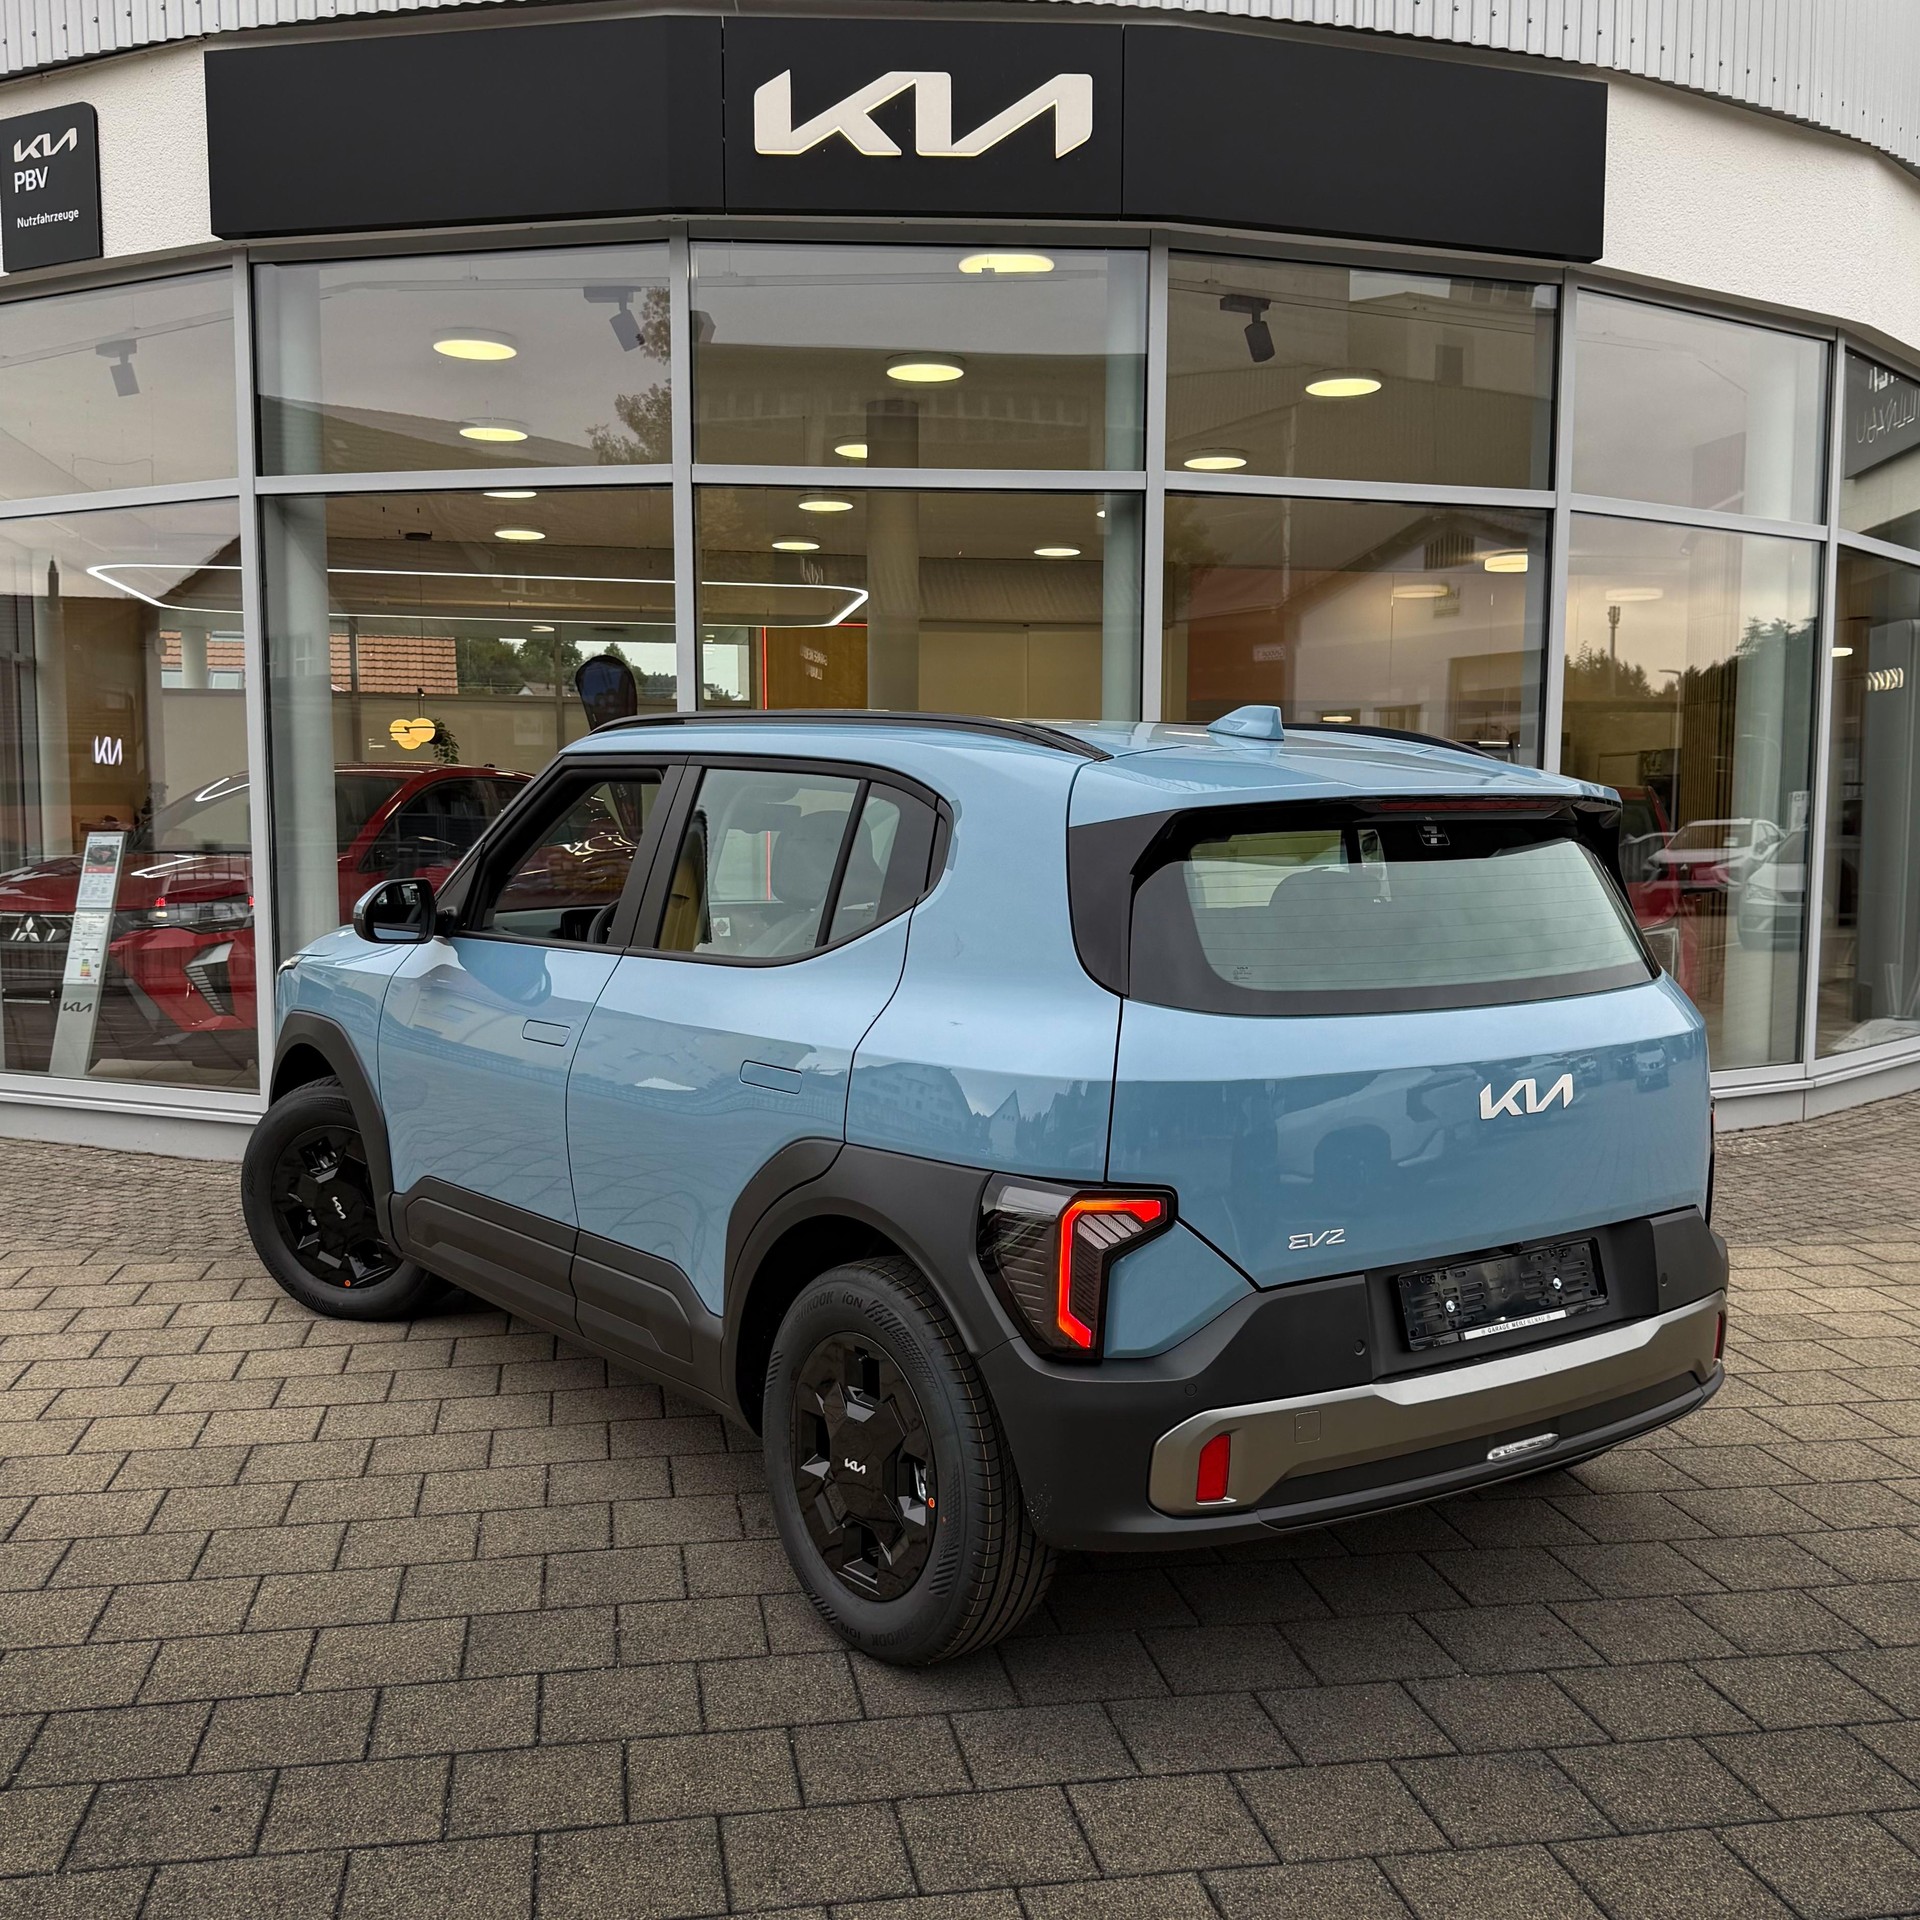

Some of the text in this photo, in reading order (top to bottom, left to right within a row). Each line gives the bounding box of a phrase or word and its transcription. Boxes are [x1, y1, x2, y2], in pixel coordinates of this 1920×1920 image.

[754, 69, 1093, 159] KIA
[13, 127, 78, 163] KIA
[14, 166, 49, 194] PBV
[17, 209, 80, 229] Nutzfahrzeuge
[94, 735, 123, 766] KIA
[62, 1001, 93, 1013] KIA
[1479, 1073, 1574, 1120] KIA
[1487, 1323, 1511, 1334] GARAGE
[844, 1457, 866, 1475] KIA
